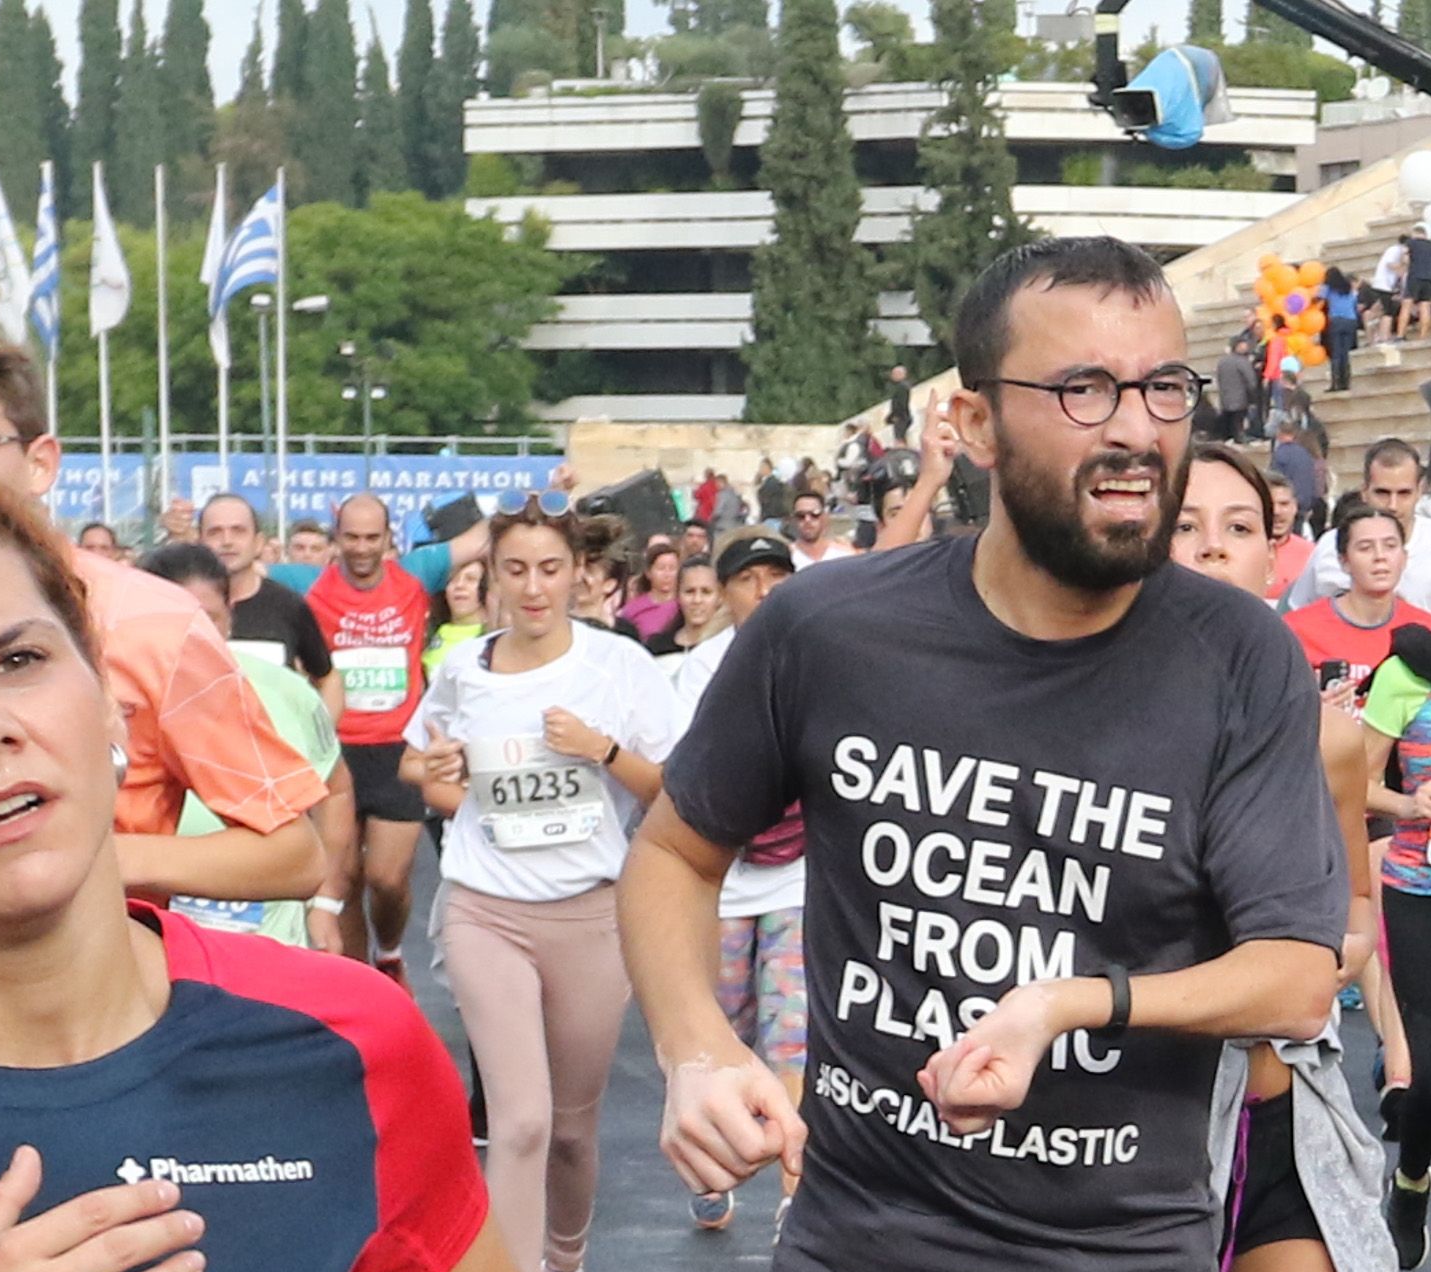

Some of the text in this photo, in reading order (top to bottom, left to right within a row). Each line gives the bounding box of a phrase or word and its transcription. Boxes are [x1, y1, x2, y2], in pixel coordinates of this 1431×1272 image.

[243, 468, 531, 488] AHENS MARATHON
[492, 768, 580, 805] 61235
[831, 735, 1172, 859] SAVE THE
[862, 821, 1111, 923] OCEAN
[878, 901, 1075, 986] FROM
[837, 960, 1122, 1074] PLASIC
[149, 1156, 314, 1184] Pharmathen
